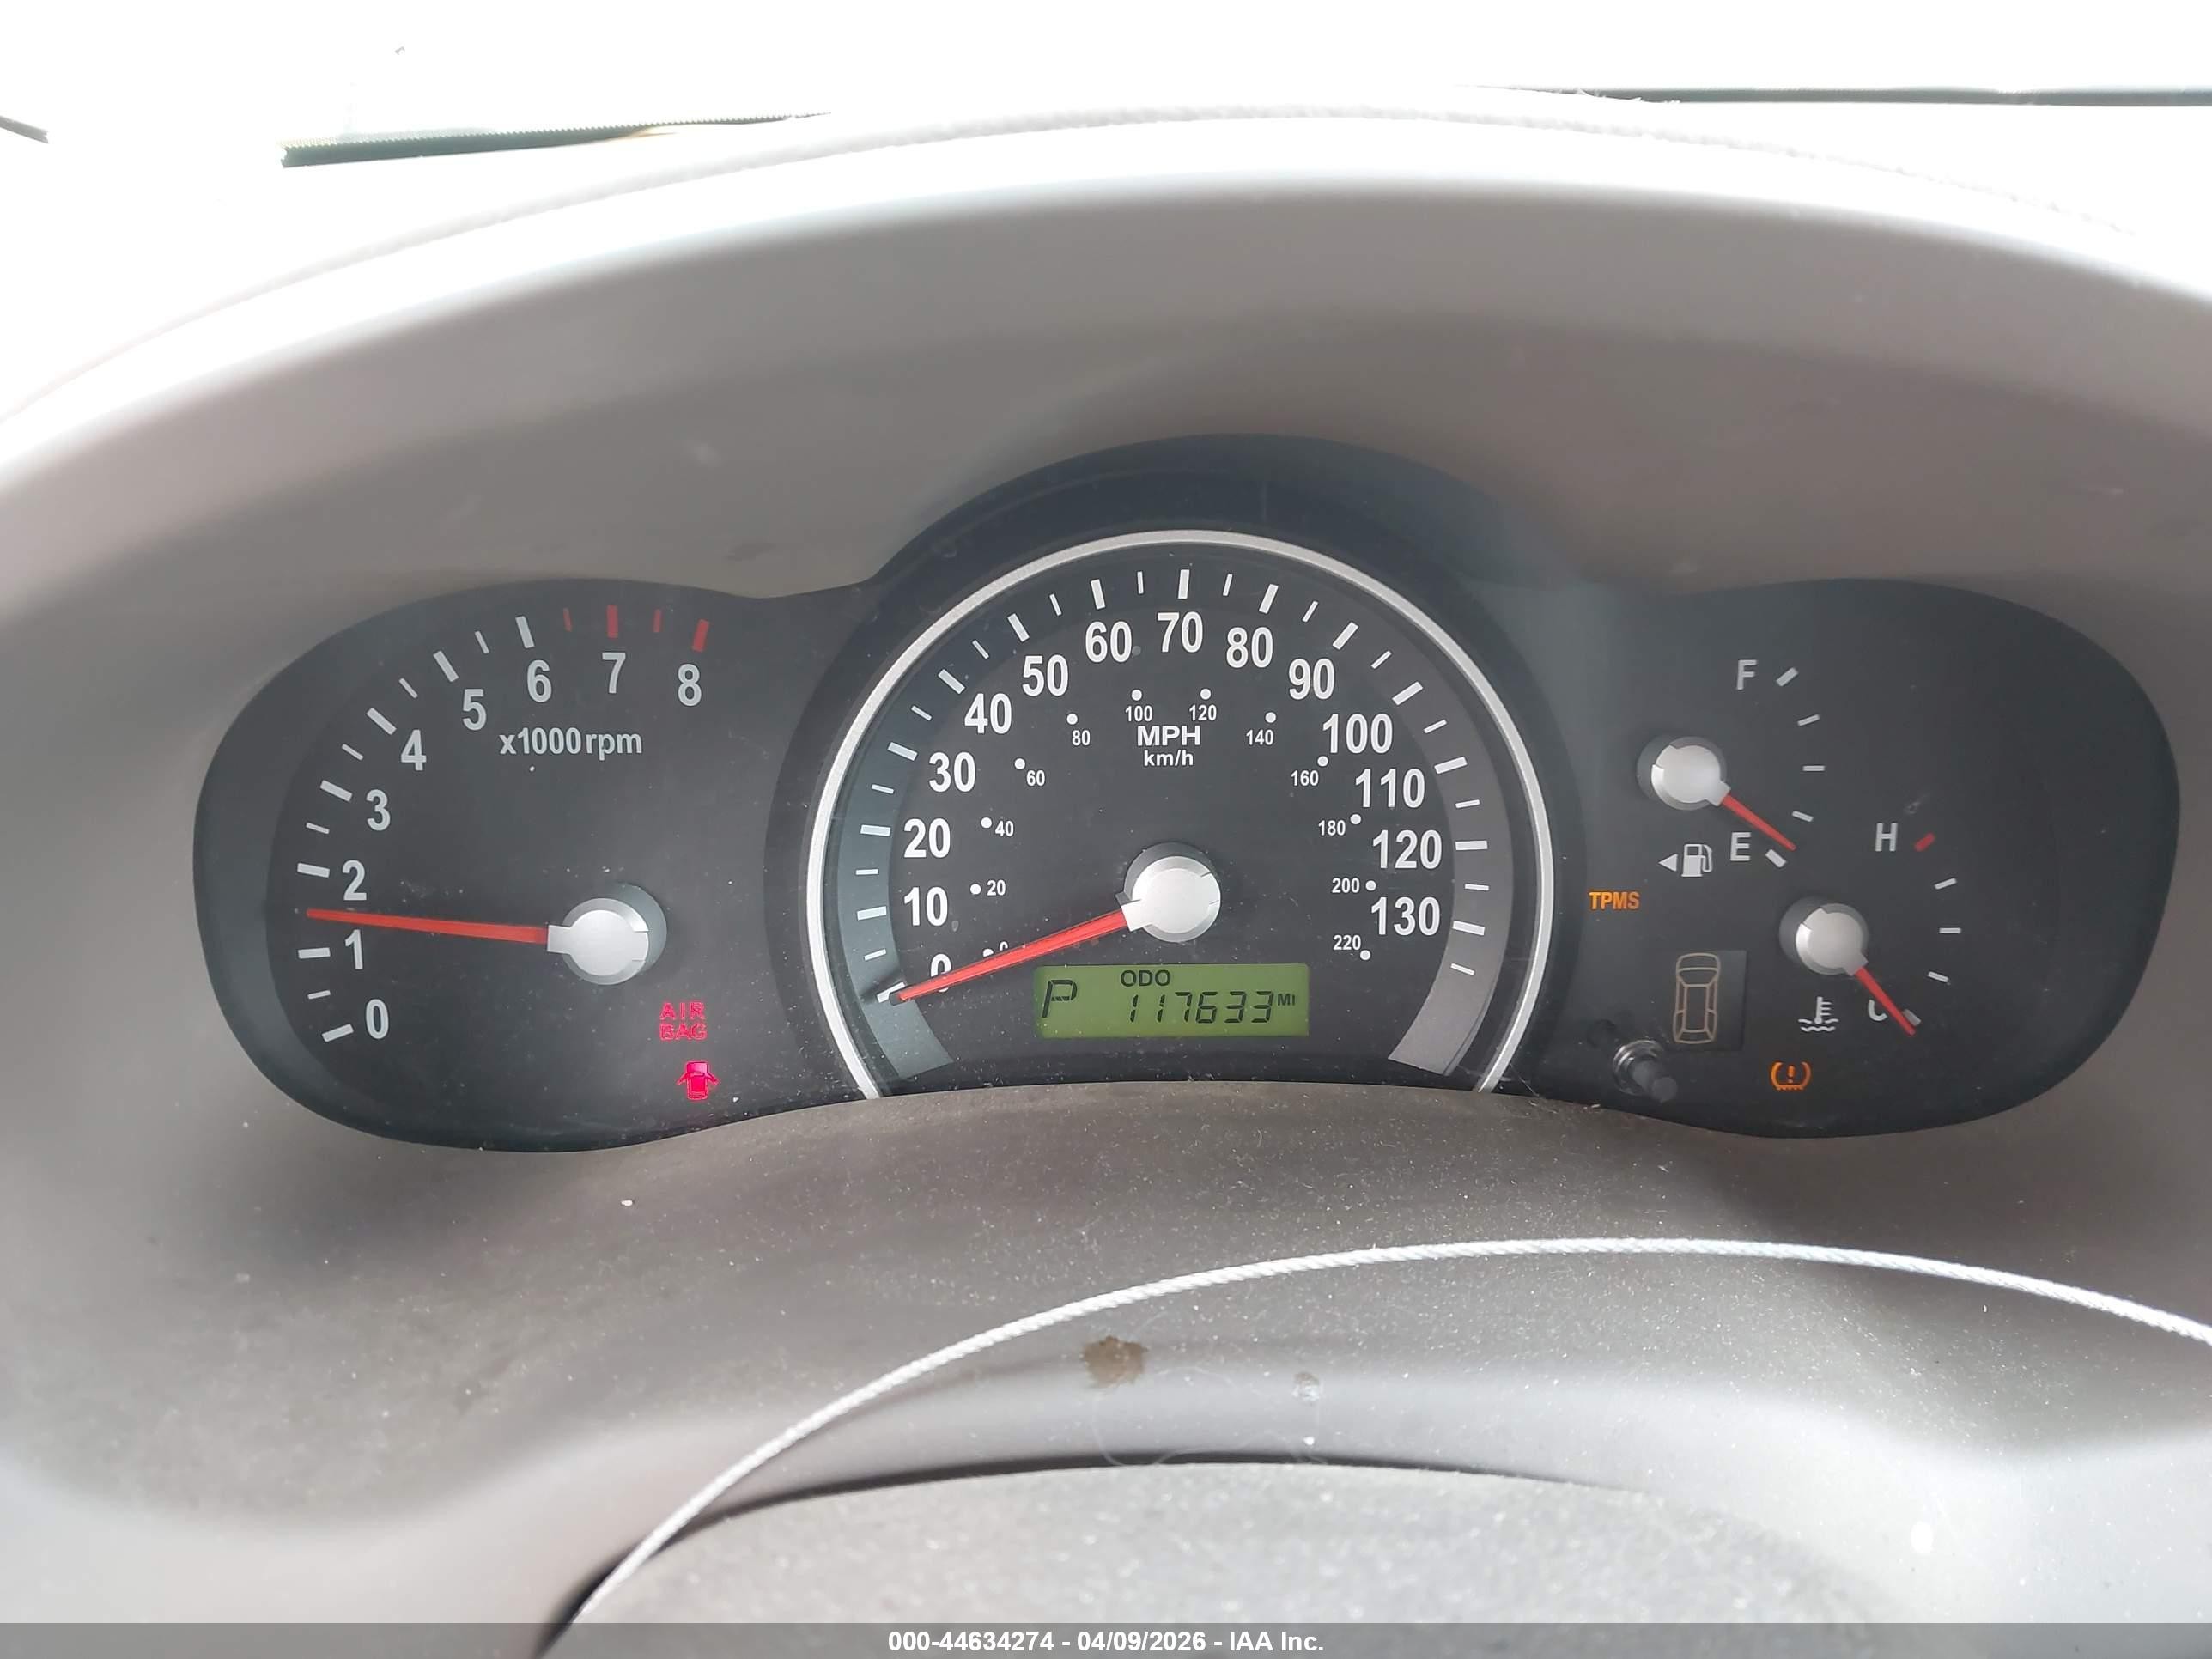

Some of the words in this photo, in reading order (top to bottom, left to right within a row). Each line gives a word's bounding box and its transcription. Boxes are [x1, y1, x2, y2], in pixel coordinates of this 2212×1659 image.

[1085, 621, 1133, 662] 60
[1157, 611, 1203, 653] 70
[1226, 627, 1273, 668] 80
[526, 659, 552, 702] 6
[602, 652, 626, 694] 7
[678, 664, 702, 706] 8
[1022, 654, 1069, 696] 50
[1288, 658, 1335, 700] 90
[1736, 659, 1759, 690] F
[462, 689, 487, 731] 5
[964, 693, 1012, 734] 40
[1125, 705, 1153, 723] 100
[1189, 704, 1218, 722] 120
[400, 729, 427, 771] 4
[1072, 729, 1091, 746] 80
[1137, 726, 1201, 747] MPH
[1246, 729, 1274, 746] 140
[1322, 714, 1393, 754] 100
[928, 752, 976, 793] 30
[1026, 769, 1046, 787] 60
[1143, 750, 1194, 767] km/h
[1291, 769, 1319, 787] 160
[1355, 769, 1425, 809] 110
[366, 789, 391, 831] 3
[994, 820, 1014, 838] 40
[1318, 819, 1346, 836] 180
[903, 818, 951, 859] 20
[1373, 830, 1442, 870] 120
[1730, 832, 1752, 861] E
[1875, 823, 1898, 852] H
[343, 860, 368, 901] 2
[987, 879, 1006, 897] 20
[1332, 878, 1360, 894] 200
[904, 887, 949, 927] 10
[1371, 897, 1441, 936] 130
[1589, 890, 1641, 911] TPMS
[344, 929, 364, 969] 1
[1333, 934, 1362, 951] 220
[1121, 970, 1171, 988] ODO
[660, 1001, 705, 1019] AIR
[1042, 979, 1078, 1019] P
[1129, 990, 1275, 1024] 117633
[1278, 994, 1296, 1006] MI
[365, 999, 389, 1039] 0
[660, 1022, 707, 1041] BAG
